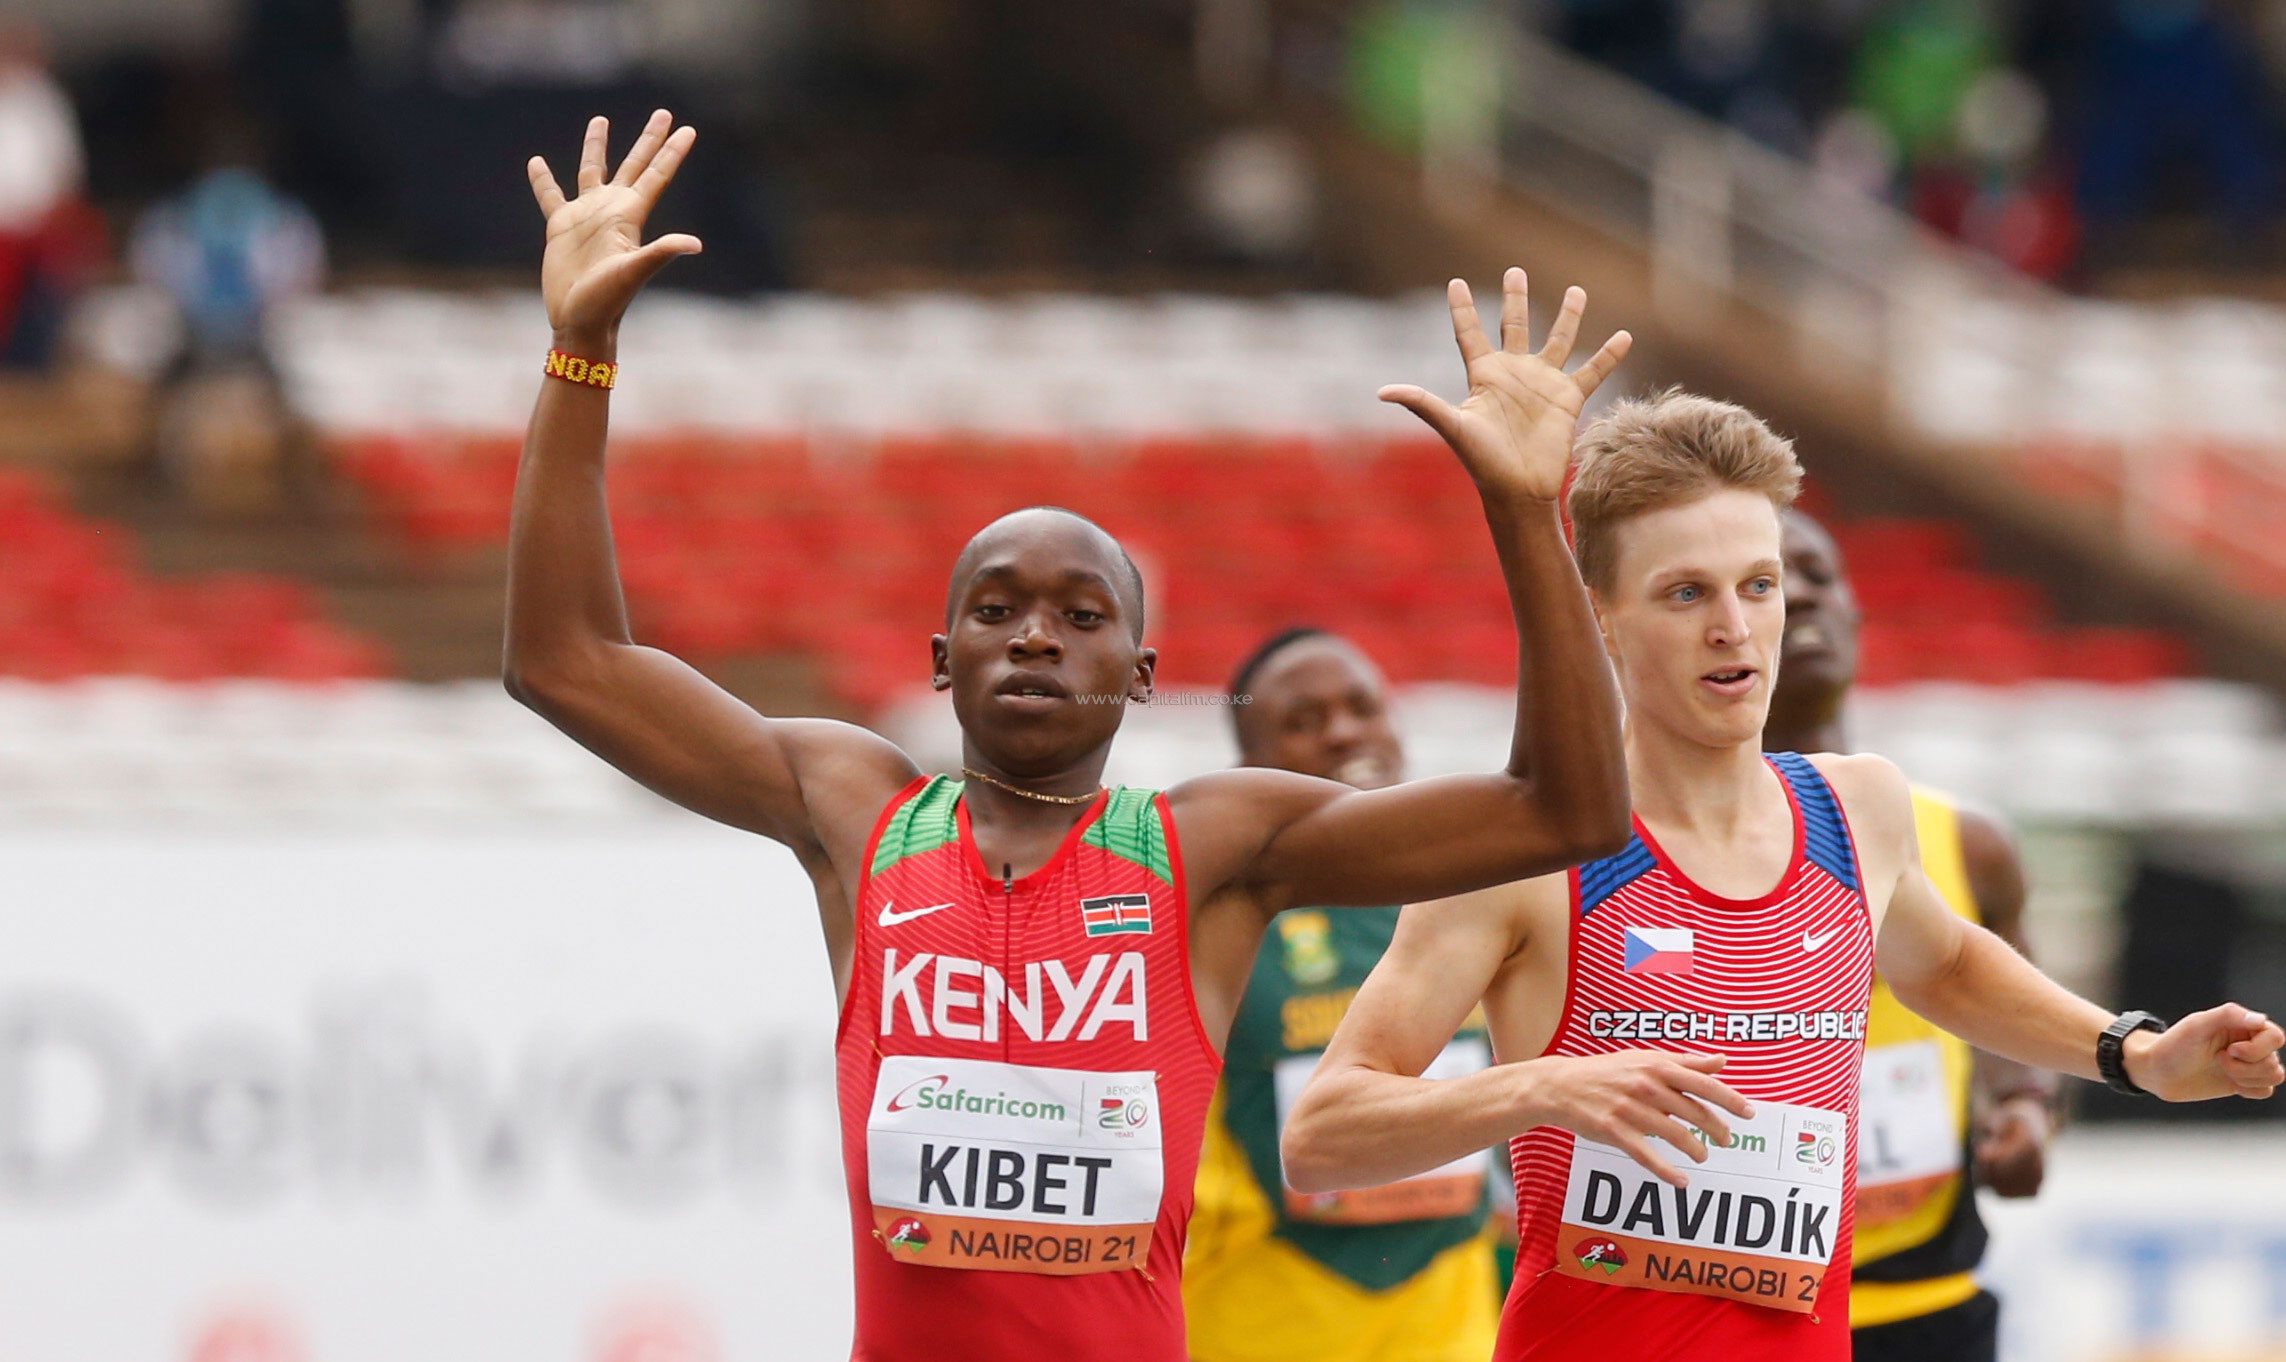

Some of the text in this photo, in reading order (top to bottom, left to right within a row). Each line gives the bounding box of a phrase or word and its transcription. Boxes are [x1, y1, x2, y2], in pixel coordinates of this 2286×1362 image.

[880, 948, 1148, 1043] KENYA
[1588, 1010, 1715, 1040] CZECH
[917, 1086, 1065, 1121] Safaricom
[1106, 1086, 1141, 1096] BEYOND
[1803, 1120, 1833, 1133] BEYOND
[919, 1144, 1112, 1216] KIBET
[1581, 1169, 1829, 1259] DAVIDÍK
[950, 1230, 1136, 1263] NAIROBI 21
[1644, 1253, 1822, 1302] NAIROBI 2
